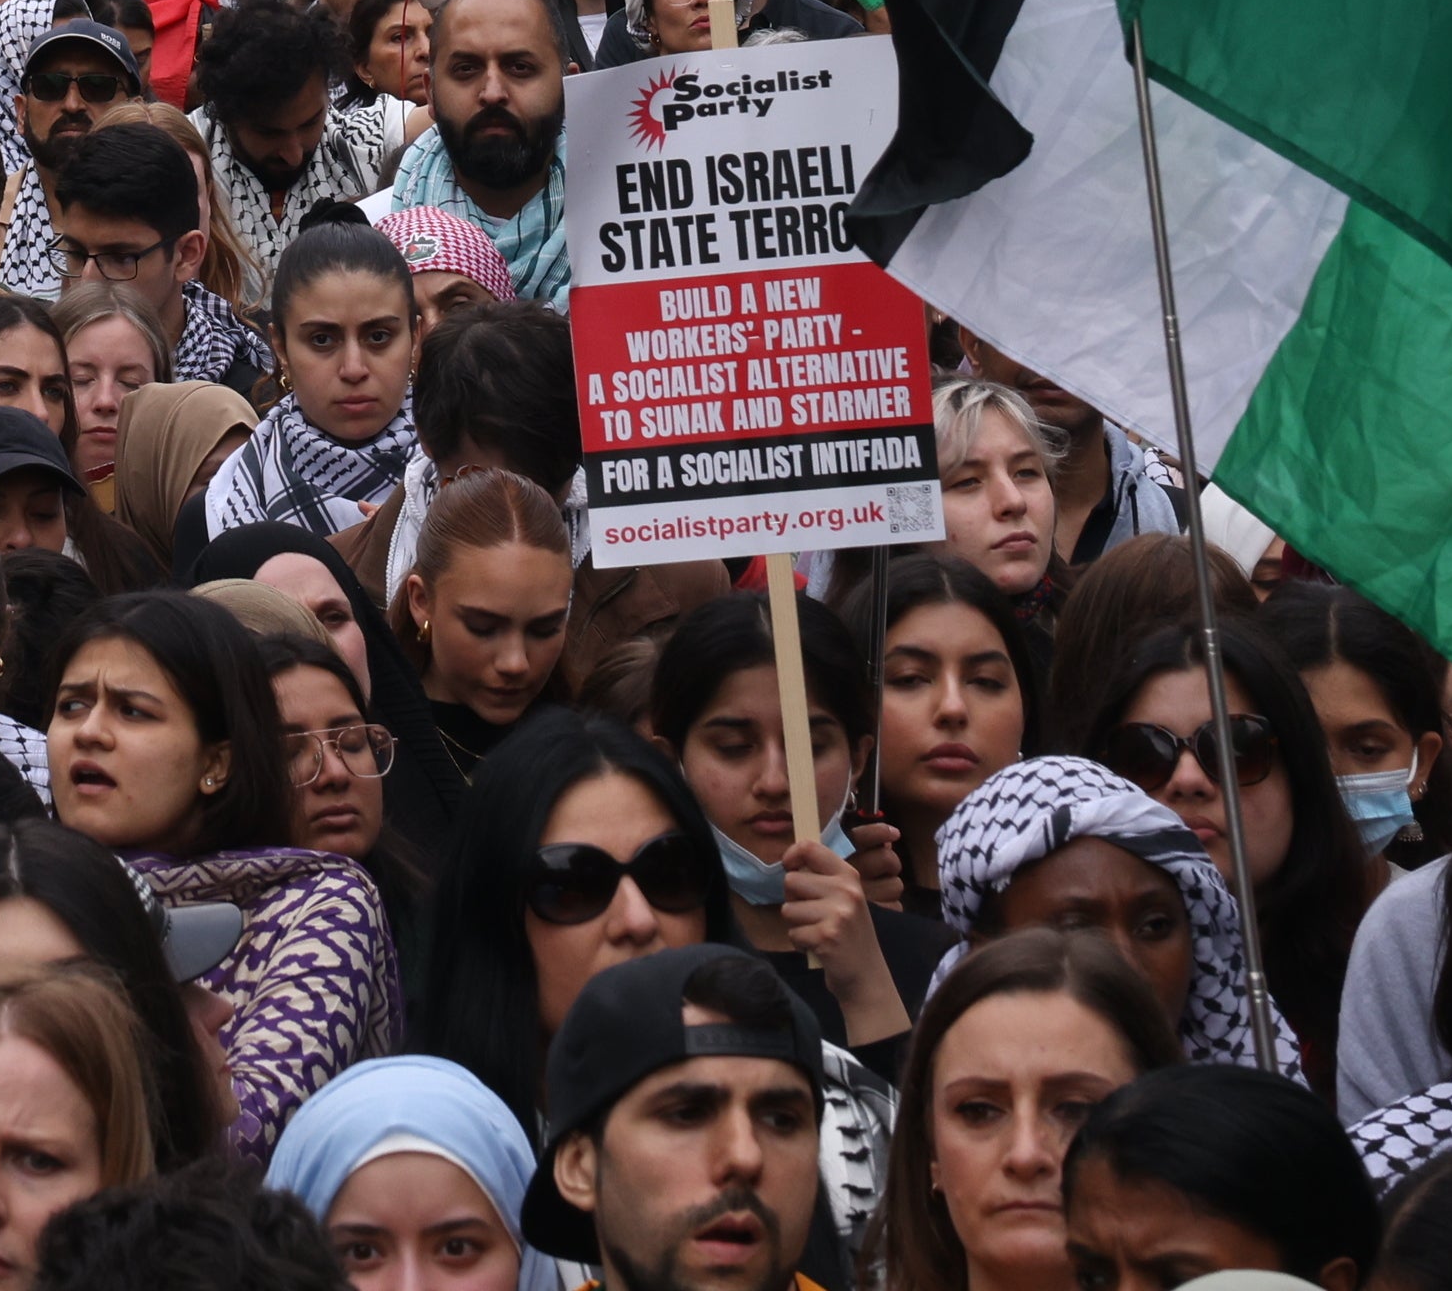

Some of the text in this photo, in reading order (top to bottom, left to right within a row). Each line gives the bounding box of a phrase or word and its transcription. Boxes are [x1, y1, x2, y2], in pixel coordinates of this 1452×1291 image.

[673, 70, 832, 102] Socialist
[616, 144, 855, 214] END ISRAELI
[599, 214, 720, 273] STATE
[660, 277, 821, 322] BUILD A NEW
[763, 314, 842, 350] PARTY
[588, 347, 910, 405] A SOCIALIST ALTERNATIVE
[600, 386, 911, 442] TO SUNAK AND STARMER
[601, 436, 922, 494] FOR A SOCIALIST INTIFADA
[605, 501, 885, 545] socialistparty.org.uk
